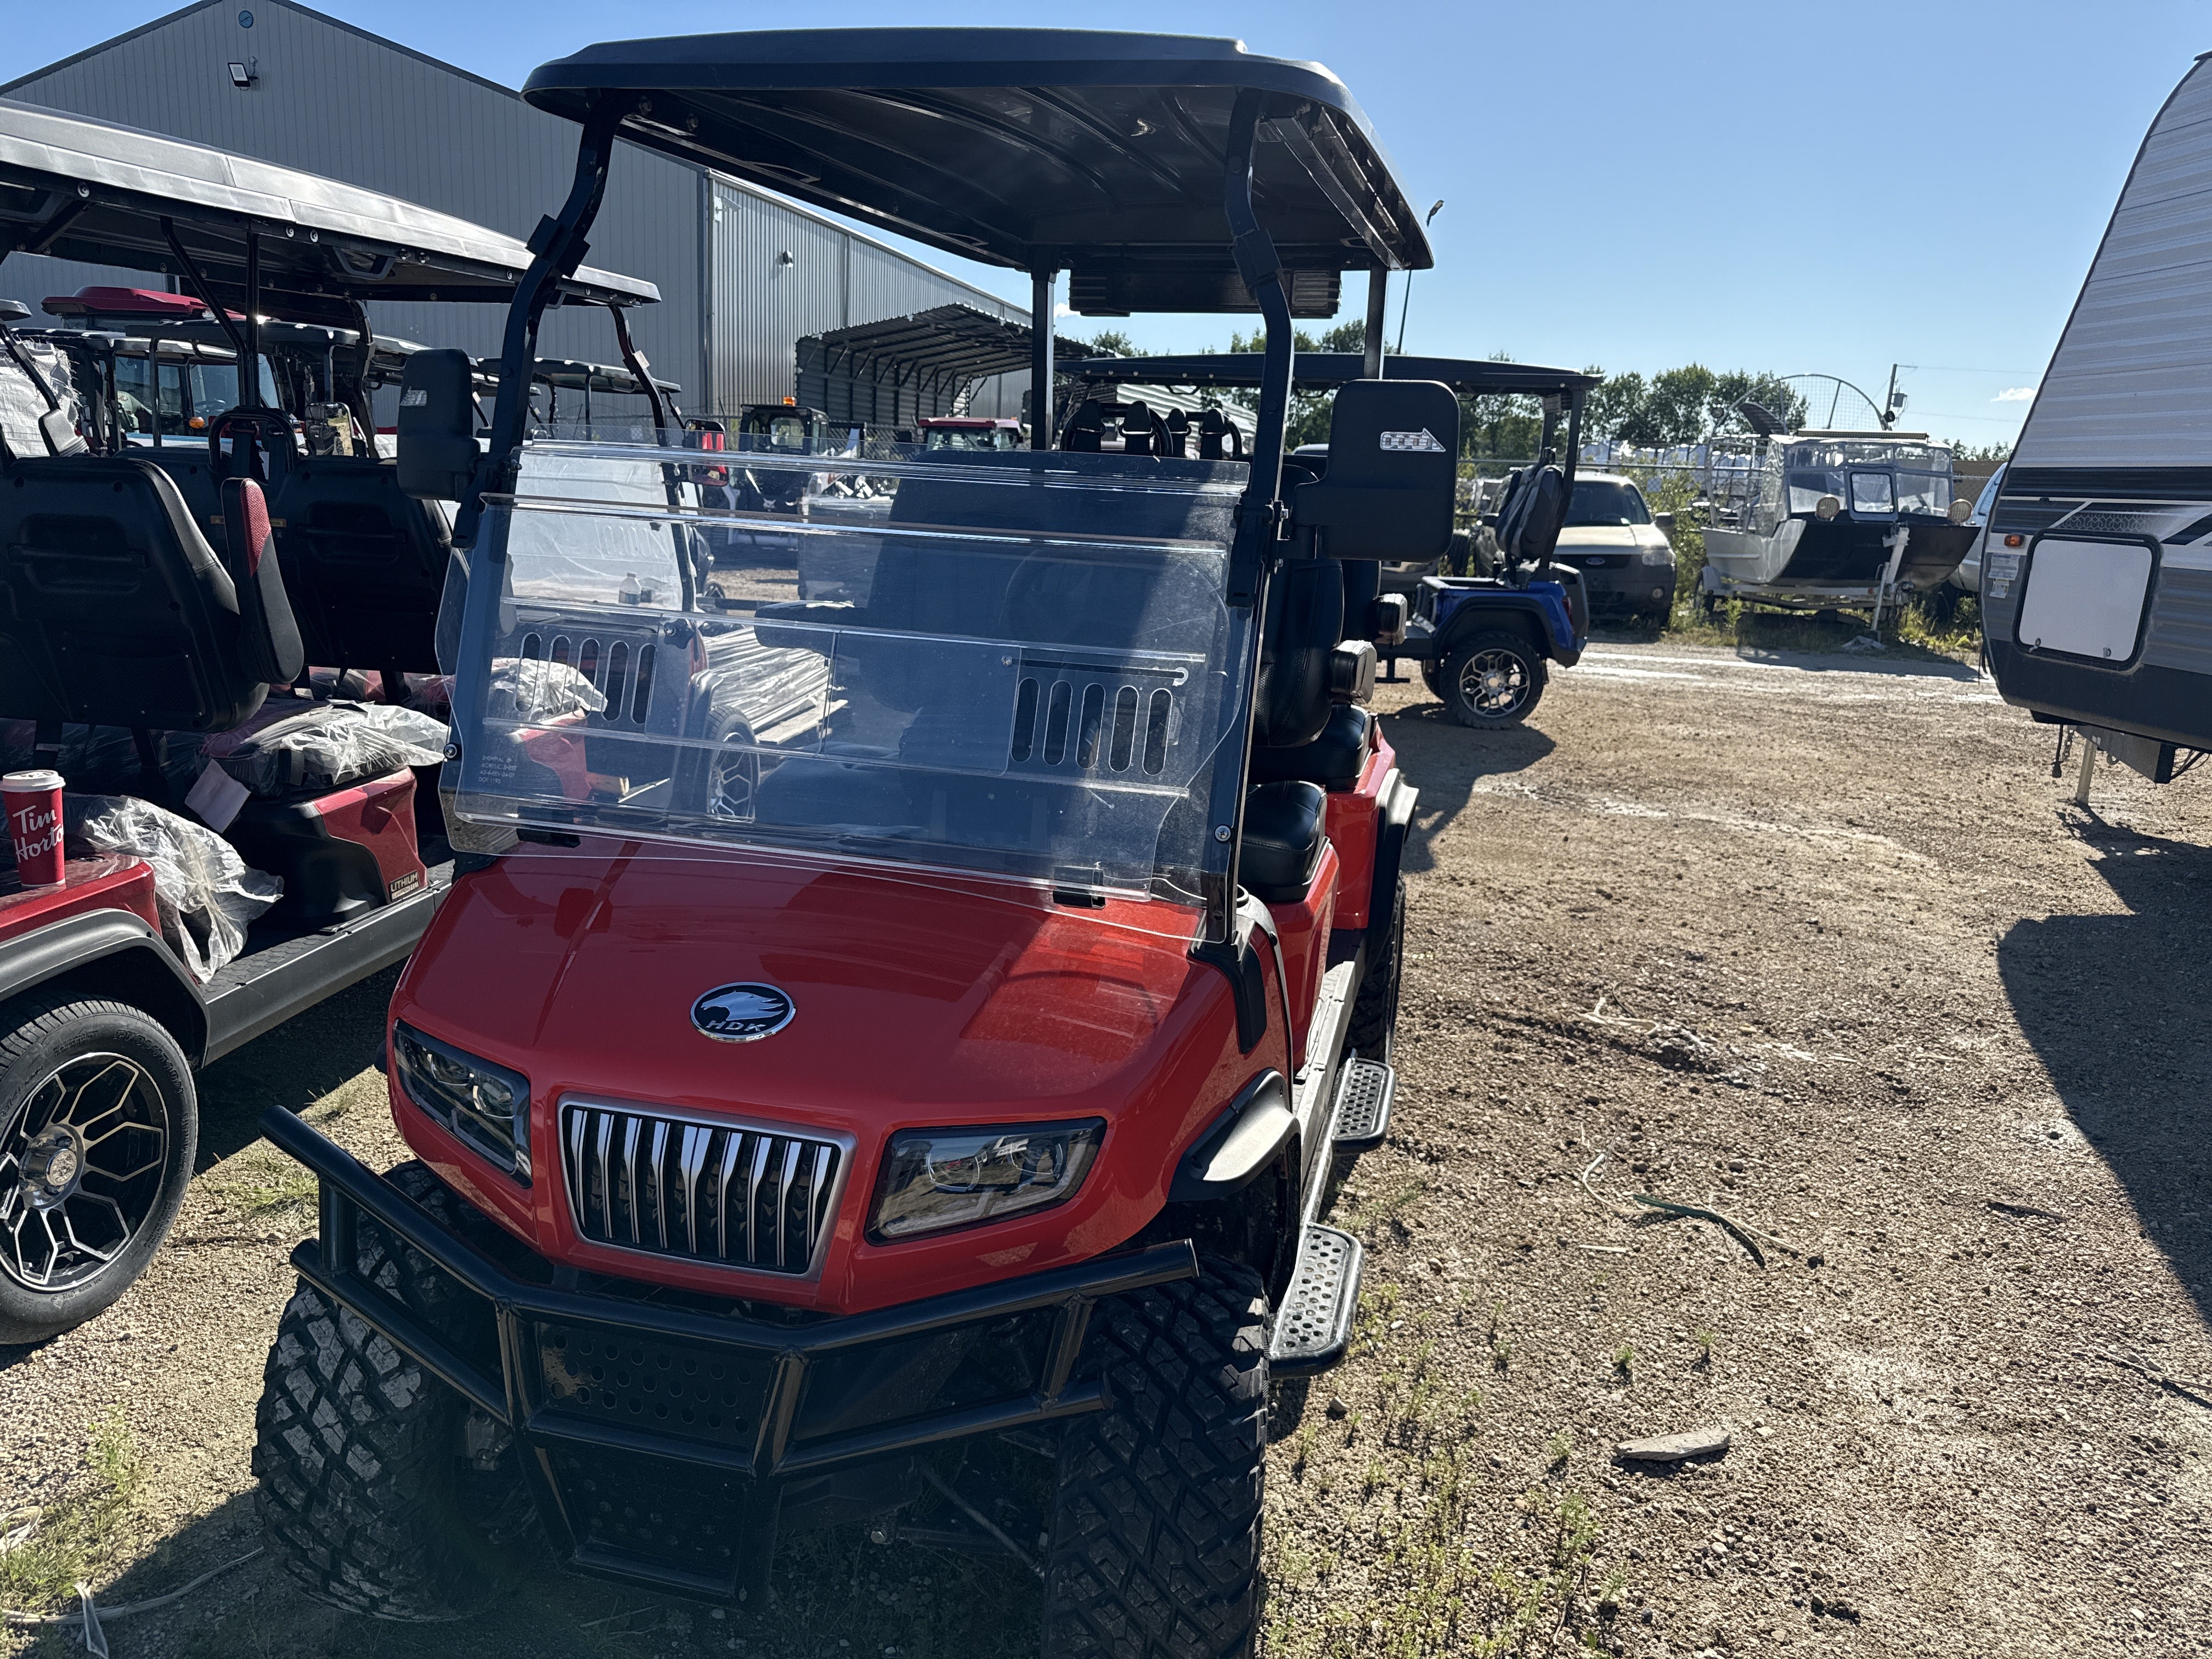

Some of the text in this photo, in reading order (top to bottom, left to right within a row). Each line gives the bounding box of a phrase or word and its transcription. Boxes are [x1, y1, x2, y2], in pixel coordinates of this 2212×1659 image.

[12, 805, 57, 834] Tim
[14, 823, 64, 864] Horto
[391, 872, 418, 892] LITHIUM
[705, 1020, 766, 1032] HDK
[113, 1028, 184, 1095] EVOLUTION
